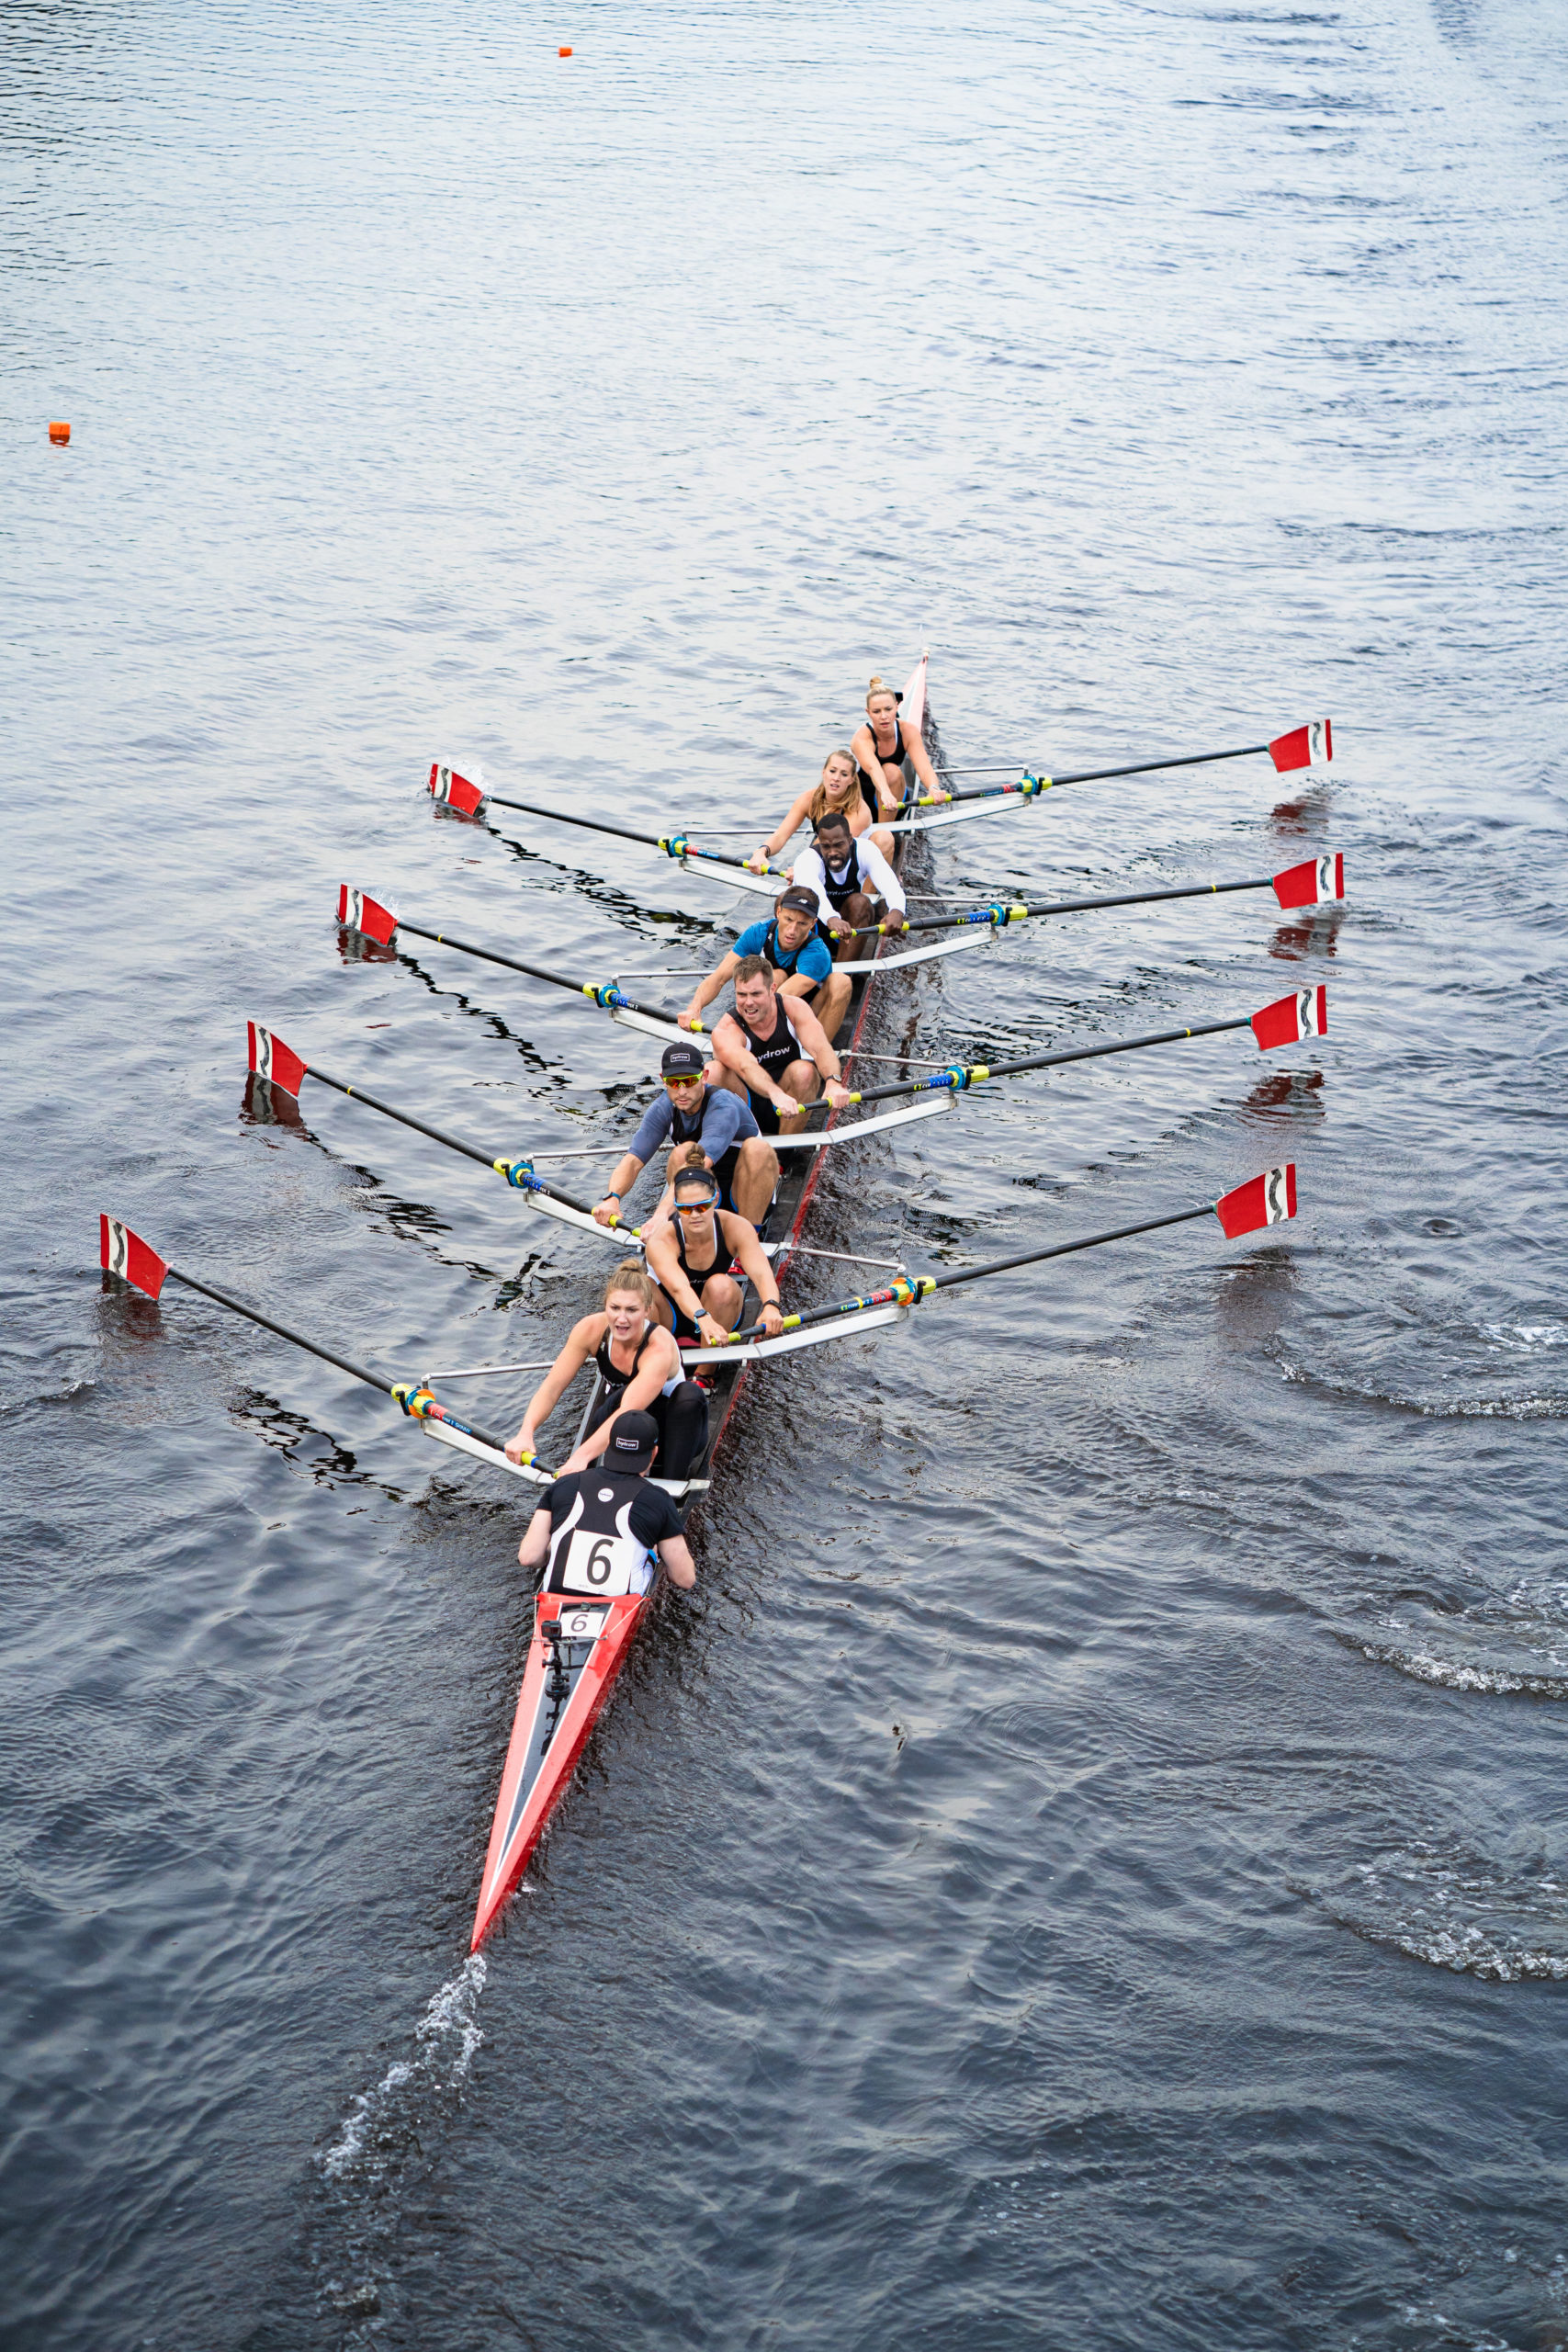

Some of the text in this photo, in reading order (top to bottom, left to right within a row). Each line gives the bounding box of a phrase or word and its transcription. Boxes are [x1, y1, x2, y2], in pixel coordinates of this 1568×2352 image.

[758, 1046, 790, 1064] ydrow
[617, 1440, 637, 1448] hydrow
[587, 1538, 615, 1586] 6
[570, 1613, 589, 1633] 6
